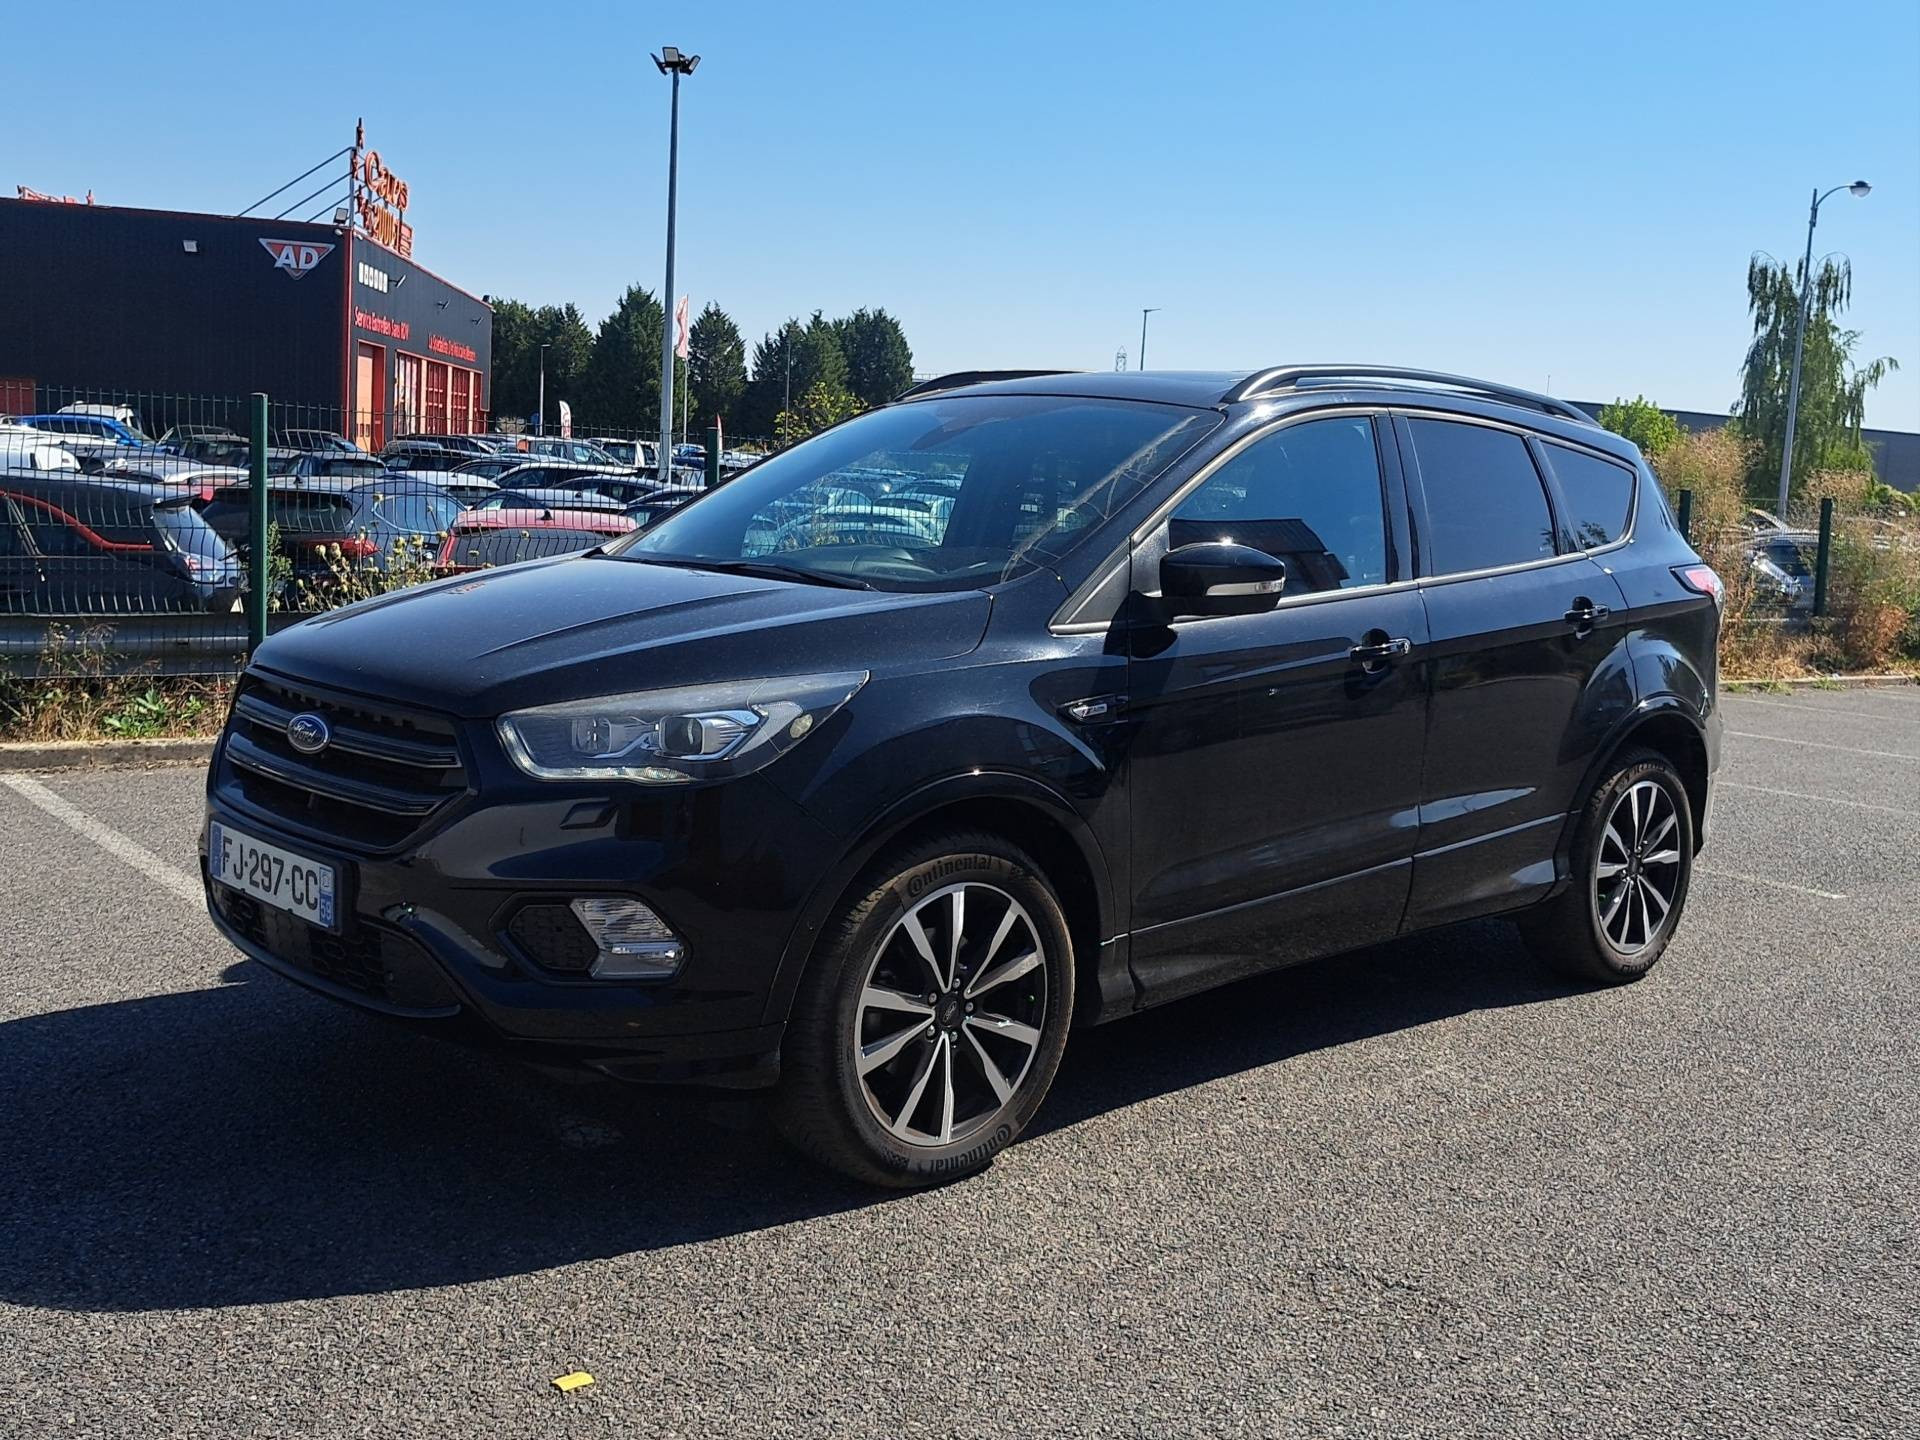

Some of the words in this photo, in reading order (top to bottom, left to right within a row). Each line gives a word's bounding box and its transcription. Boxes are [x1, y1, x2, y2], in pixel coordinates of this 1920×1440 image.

[274, 245, 319, 270] AD
[222, 835, 318, 910] FJ-297-CC
[907, 854, 992, 897] Continental
[320, 898, 333, 919] 59
